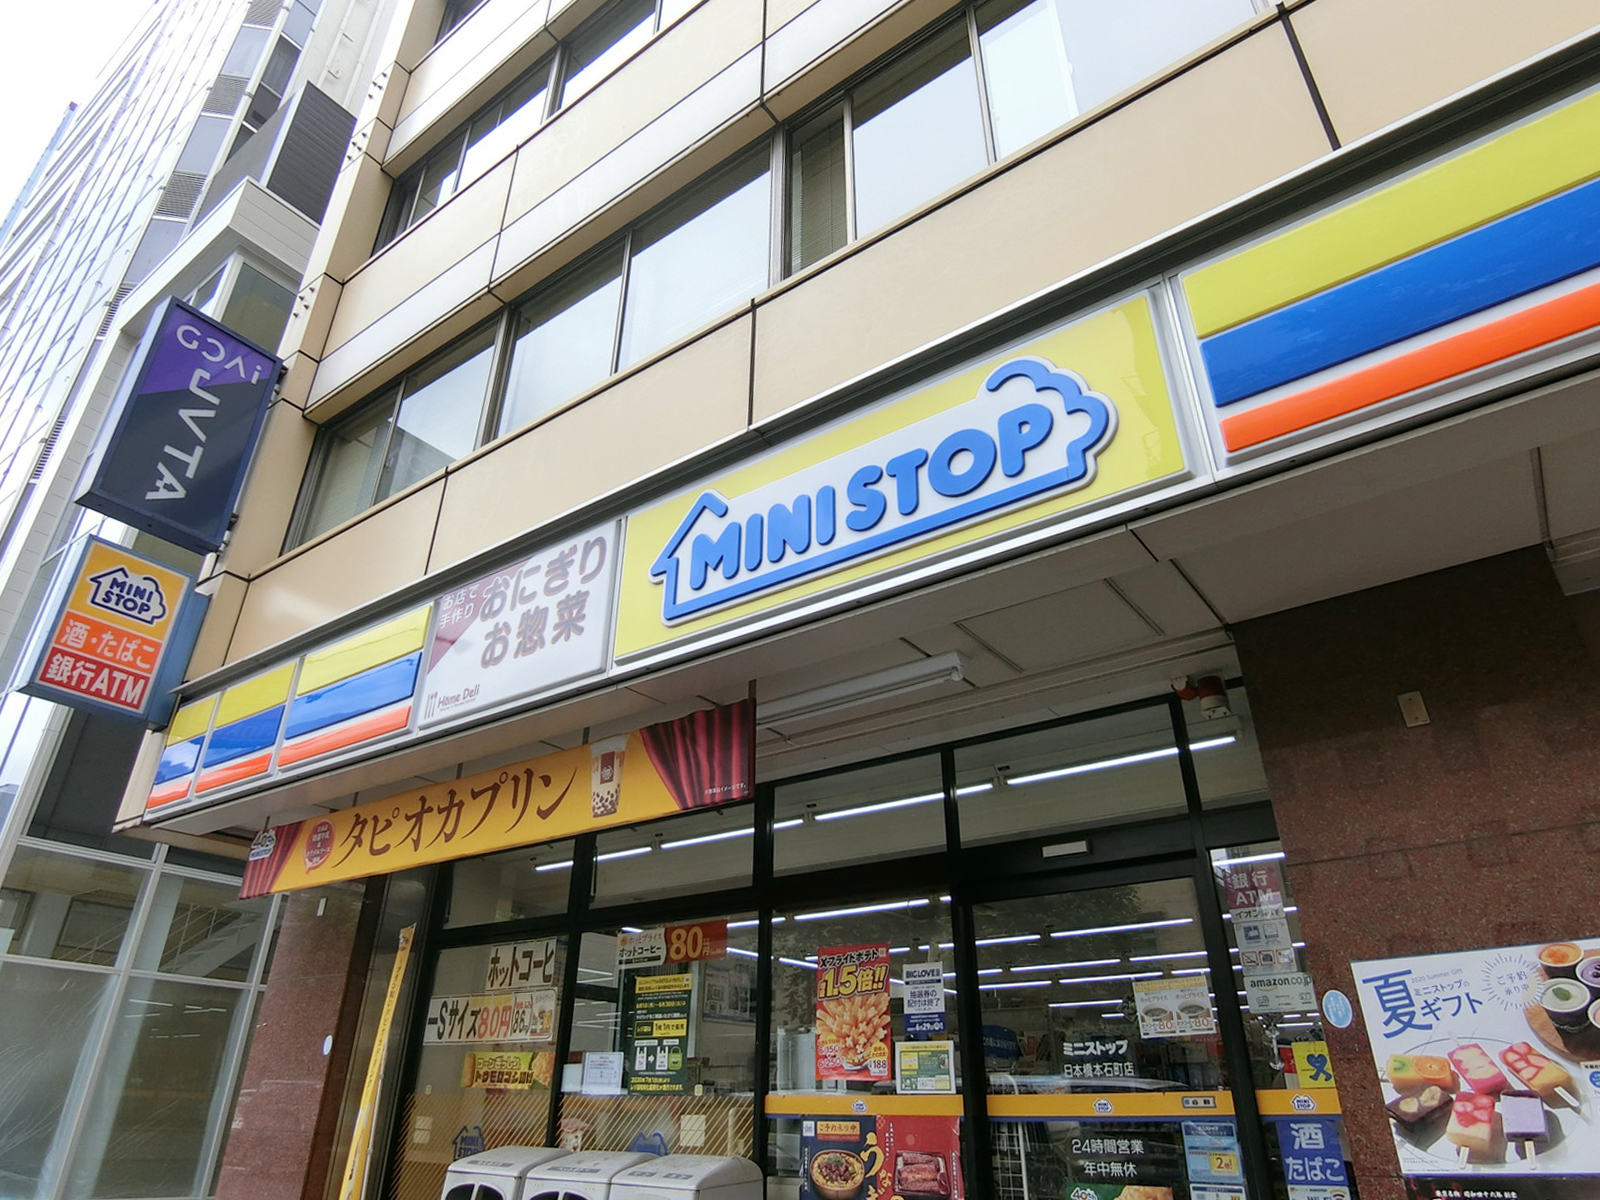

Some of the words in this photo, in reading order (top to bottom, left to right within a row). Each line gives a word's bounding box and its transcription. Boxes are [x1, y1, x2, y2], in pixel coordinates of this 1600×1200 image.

[145, 368, 221, 500] JVTA
[110, 577, 155, 605] MINI
[479, 536, 607, 622] おにぎり
[102, 589, 152, 615] STOP
[443, 584, 480, 609] お店で
[439, 602, 474, 629] 手作り
[481, 590, 590, 669] お惣菜
[46, 652, 147, 707] 銀行ATM
[438, 694, 461, 708] Home
[462, 683, 481, 700] Deli
[331, 766, 578, 868] タピオカプリン
[1231, 869, 1268, 889] 銀行
[1236, 888, 1274, 905] ATM
[1250, 975, 1313, 988] amazon.co.jp
[1414, 979, 1471, 997] ミニストップの
[1497, 970, 1529, 986] ご予約
[1504, 983, 1530, 996] 承り中
[1362, 969, 1433, 1039] 夏
[1420, 992, 1484, 1021] ギフト
[1063, 1039, 1129, 1056] ミニストップ
[1063, 1062, 1135, 1078] 日本橋本石町店
[1072, 1139, 1145, 1154] 24時間営業
[1290, 1123, 1325, 1150] 酒
[1083, 1161, 1138, 1177] 年中無休
[1285, 1156, 1345, 1181] たばこ
